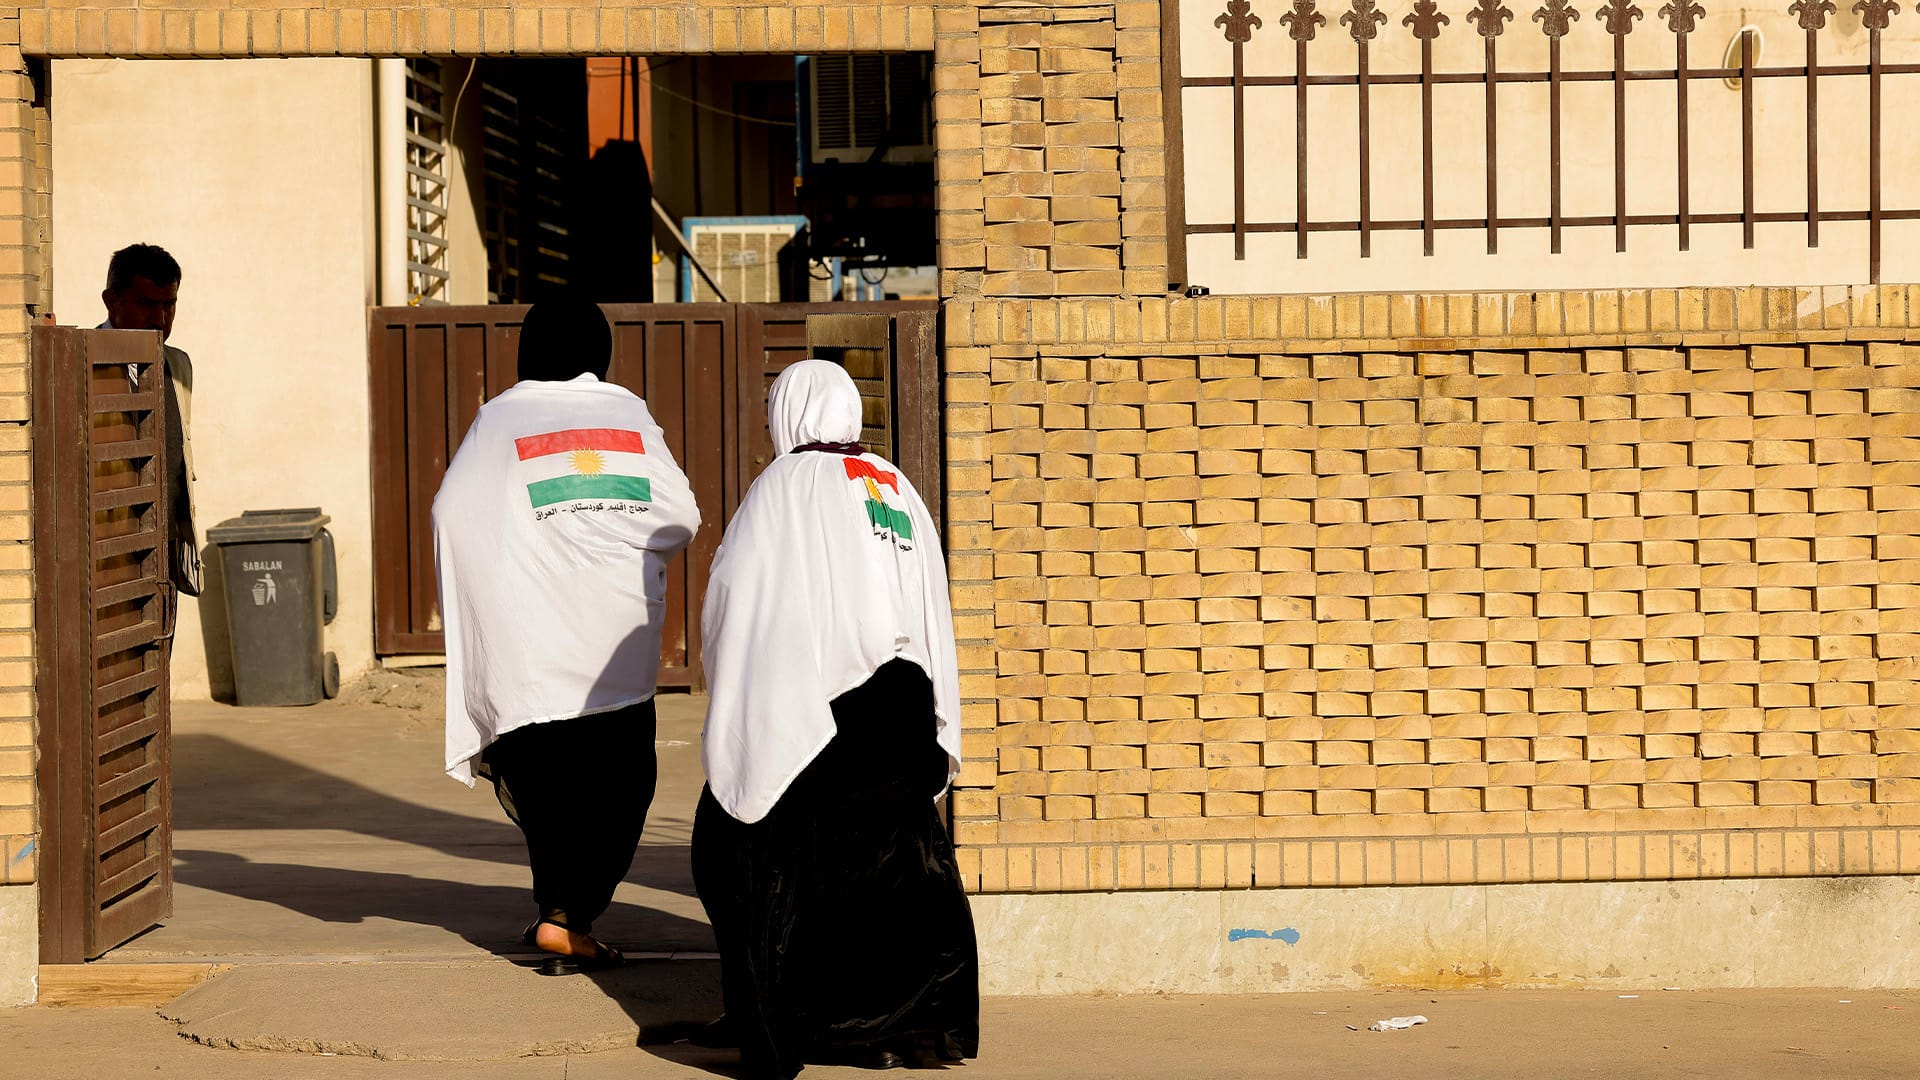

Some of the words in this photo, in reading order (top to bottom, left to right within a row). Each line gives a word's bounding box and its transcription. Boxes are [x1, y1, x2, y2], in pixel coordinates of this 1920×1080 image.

[570, 502, 604, 513] كوردستان
[607, 503, 627, 513] إقليم
[629, 504, 649, 514] حجاج
[535, 508, 558, 521] العراق
[242, 560, 282, 571] SABALAN
